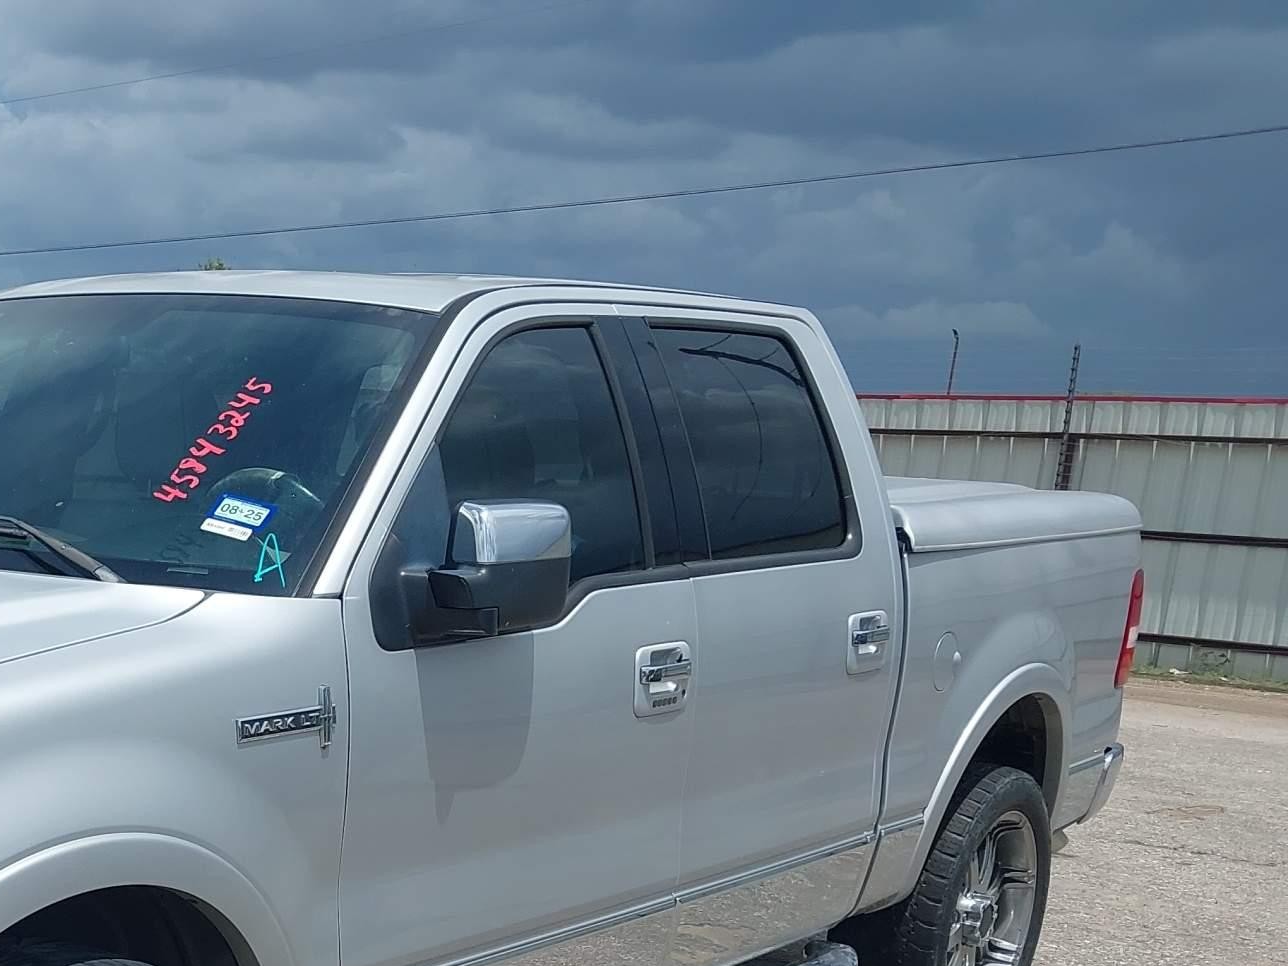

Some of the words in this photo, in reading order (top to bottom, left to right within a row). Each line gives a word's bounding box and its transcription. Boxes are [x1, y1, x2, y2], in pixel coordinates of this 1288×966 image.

[153, 376, 274, 503] 45843245
[220, 503, 240, 515] 08
[244, 509, 264, 521] 25
[253, 532, 286, 588] A
[244, 715, 297, 737] MARK
[300, 712, 321, 727] LT
